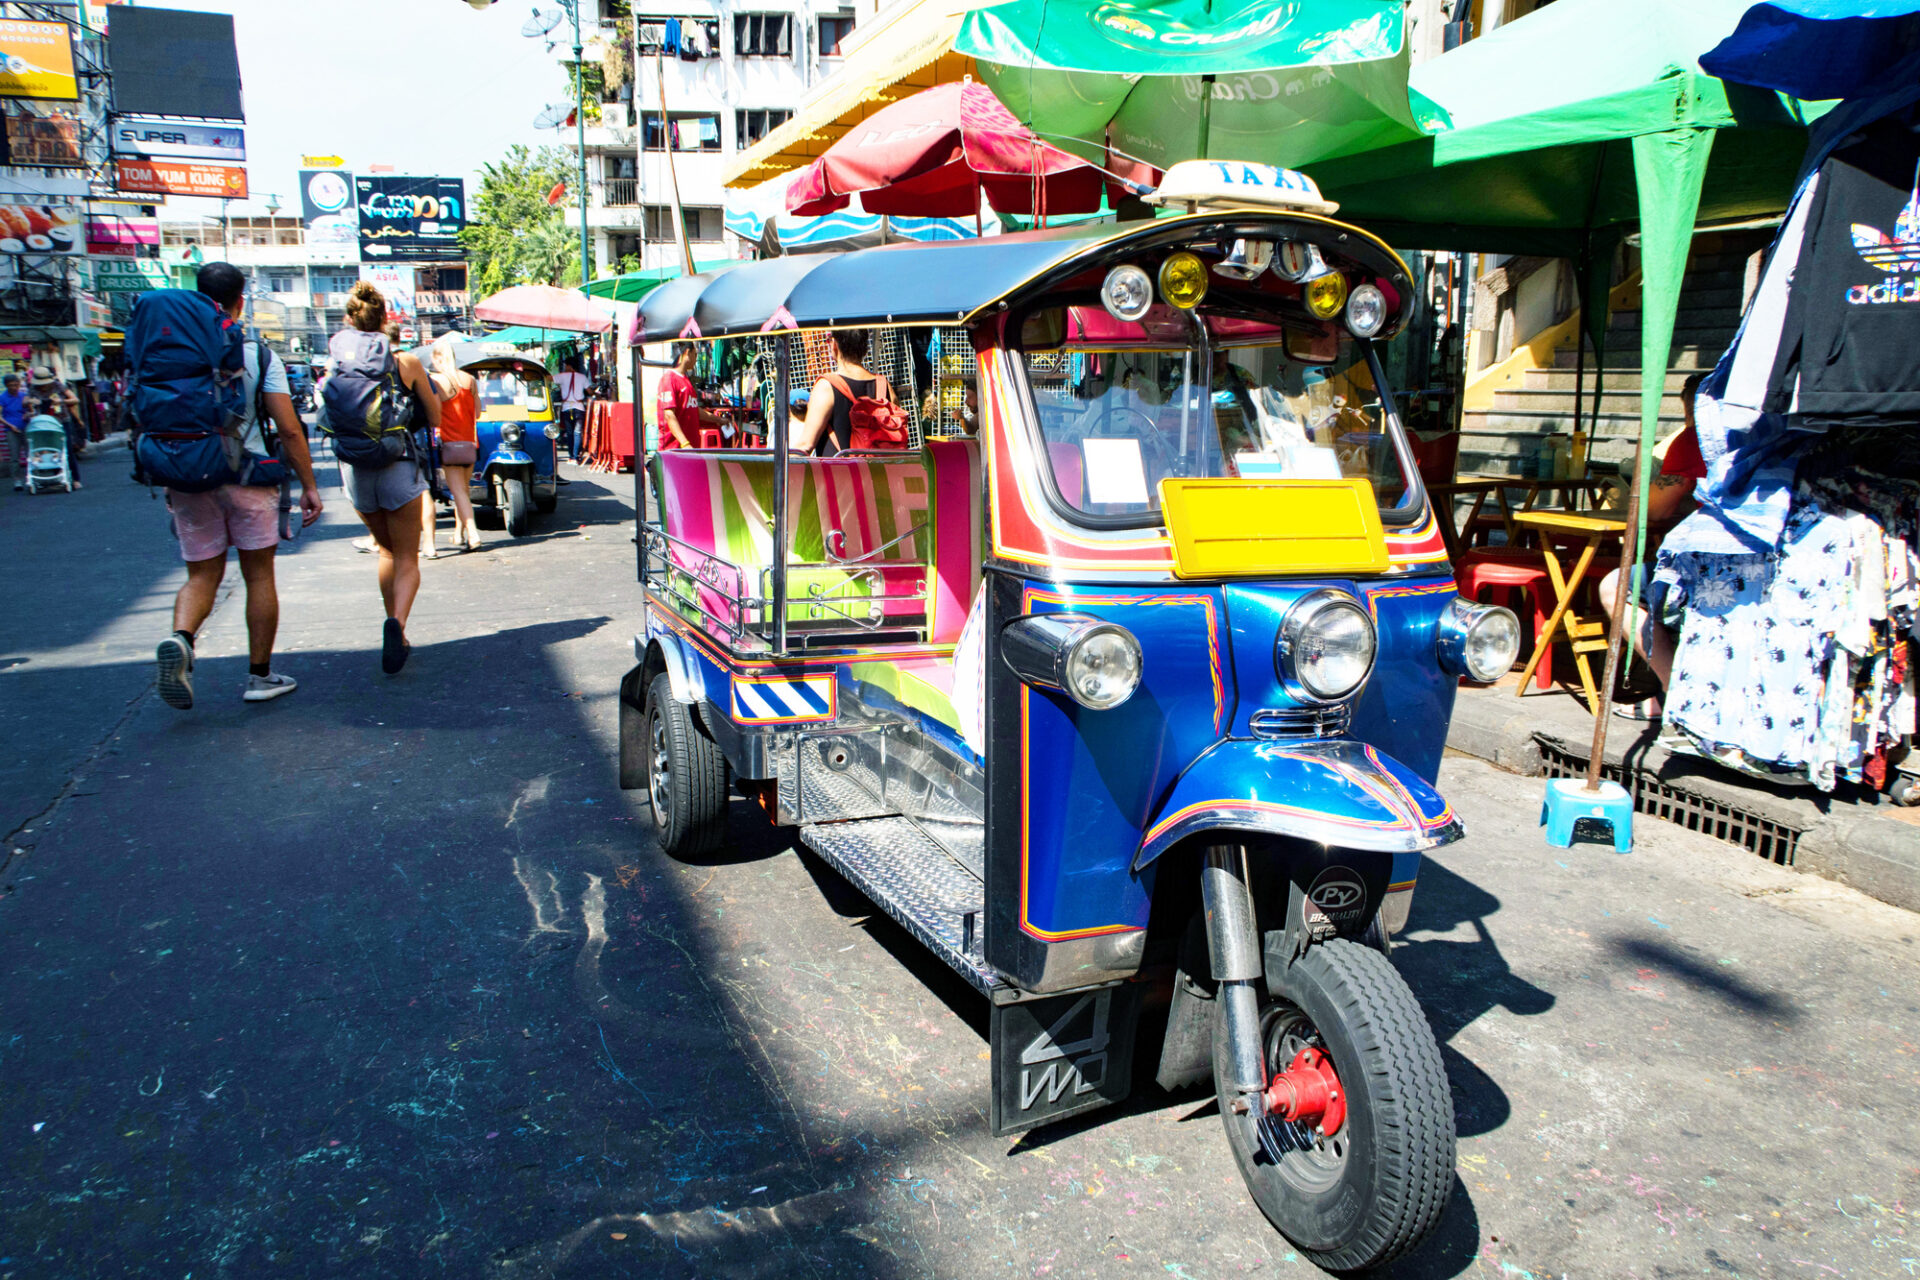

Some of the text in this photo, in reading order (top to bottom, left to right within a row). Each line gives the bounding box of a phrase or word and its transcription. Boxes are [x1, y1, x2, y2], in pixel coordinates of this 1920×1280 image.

[120, 129, 187, 144] SUPER
[122, 167, 152, 181] TOM
[156, 169, 187, 185] YUM
[189, 172, 226, 187] KUNG
[1210, 161, 1311, 193] TAXI
[99, 260, 164, 274] ขายยา
[100, 276, 169, 290] DRUGSTORE
[376, 273, 399, 281] ASIA
[418, 294, 462, 304] INDIAN
[425, 305, 458, 313] FOOD
[1309, 909, 1361, 924] HI-QUALITY
